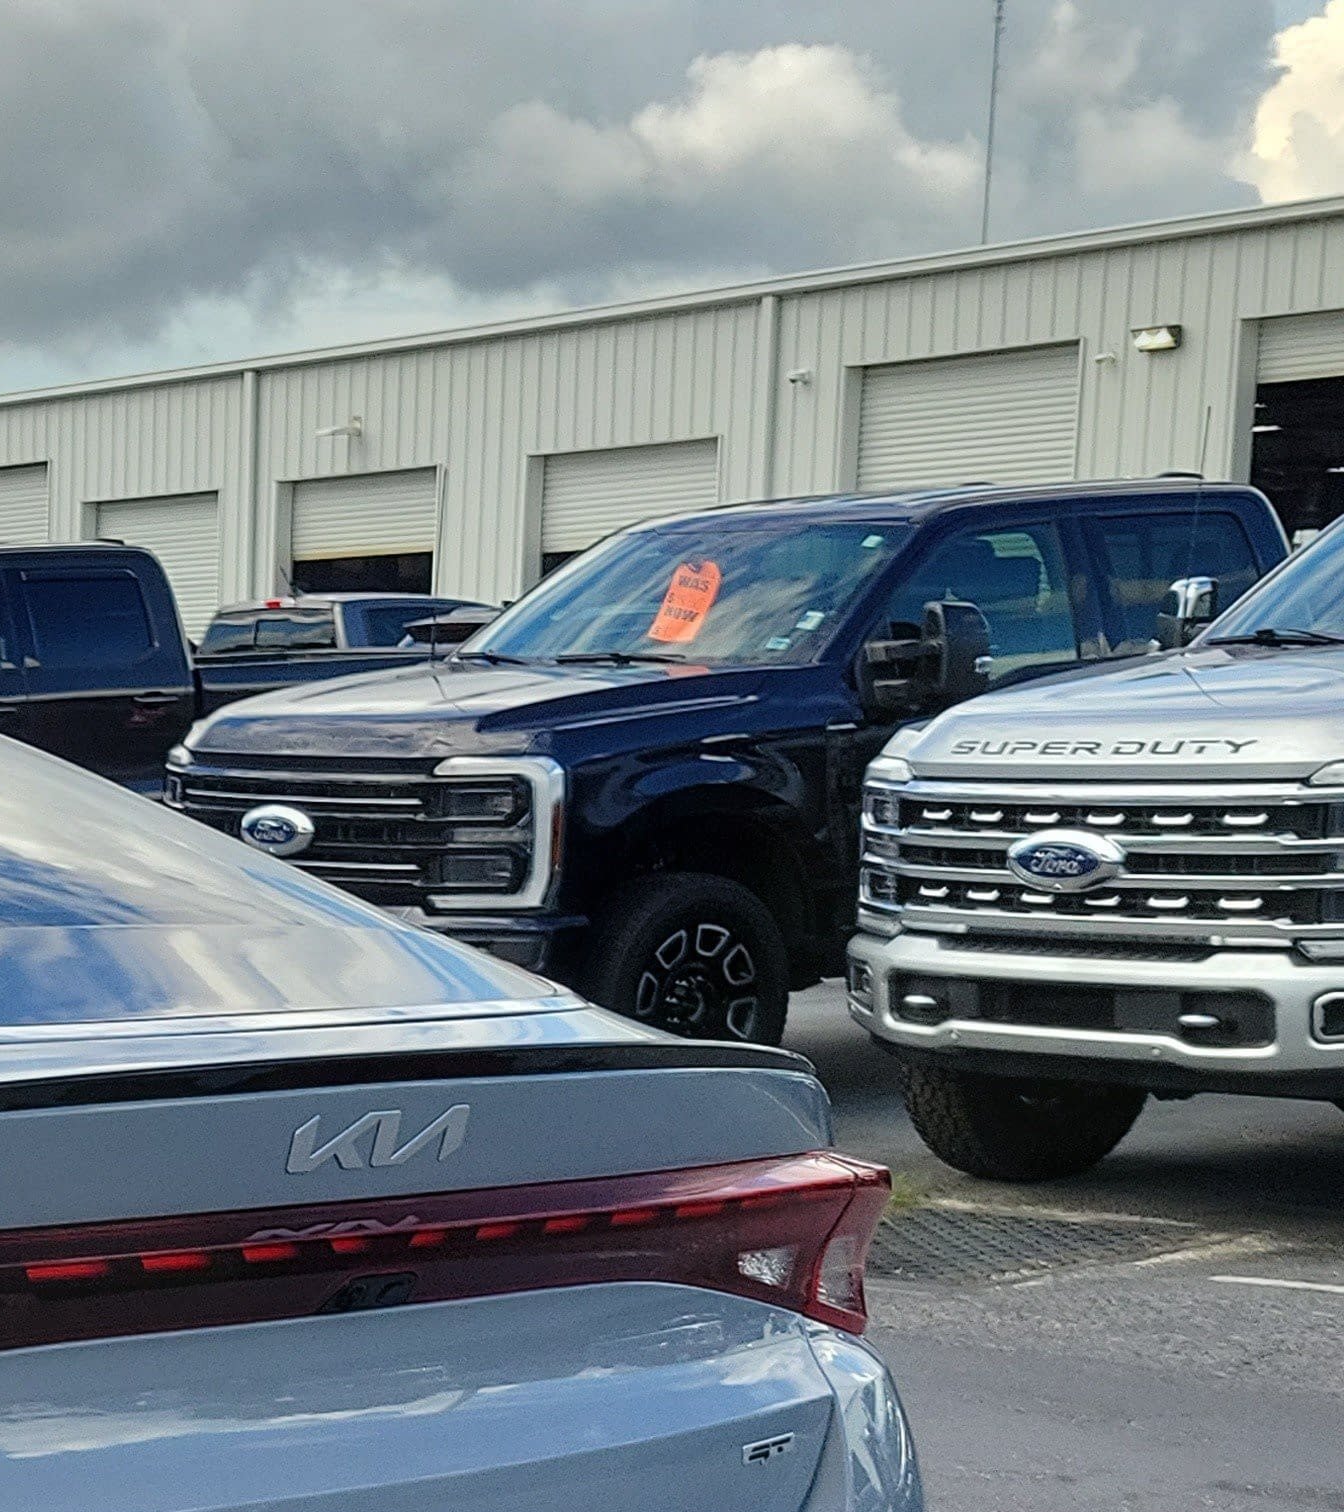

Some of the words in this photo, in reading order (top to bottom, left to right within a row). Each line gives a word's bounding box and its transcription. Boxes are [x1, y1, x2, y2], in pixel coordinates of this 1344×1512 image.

[950, 739, 1102, 756] SUPER
[1109, 738, 1258, 756] DUTY
[1030, 846, 1086, 875] Ford
[285, 1103, 471, 1174] KIA
